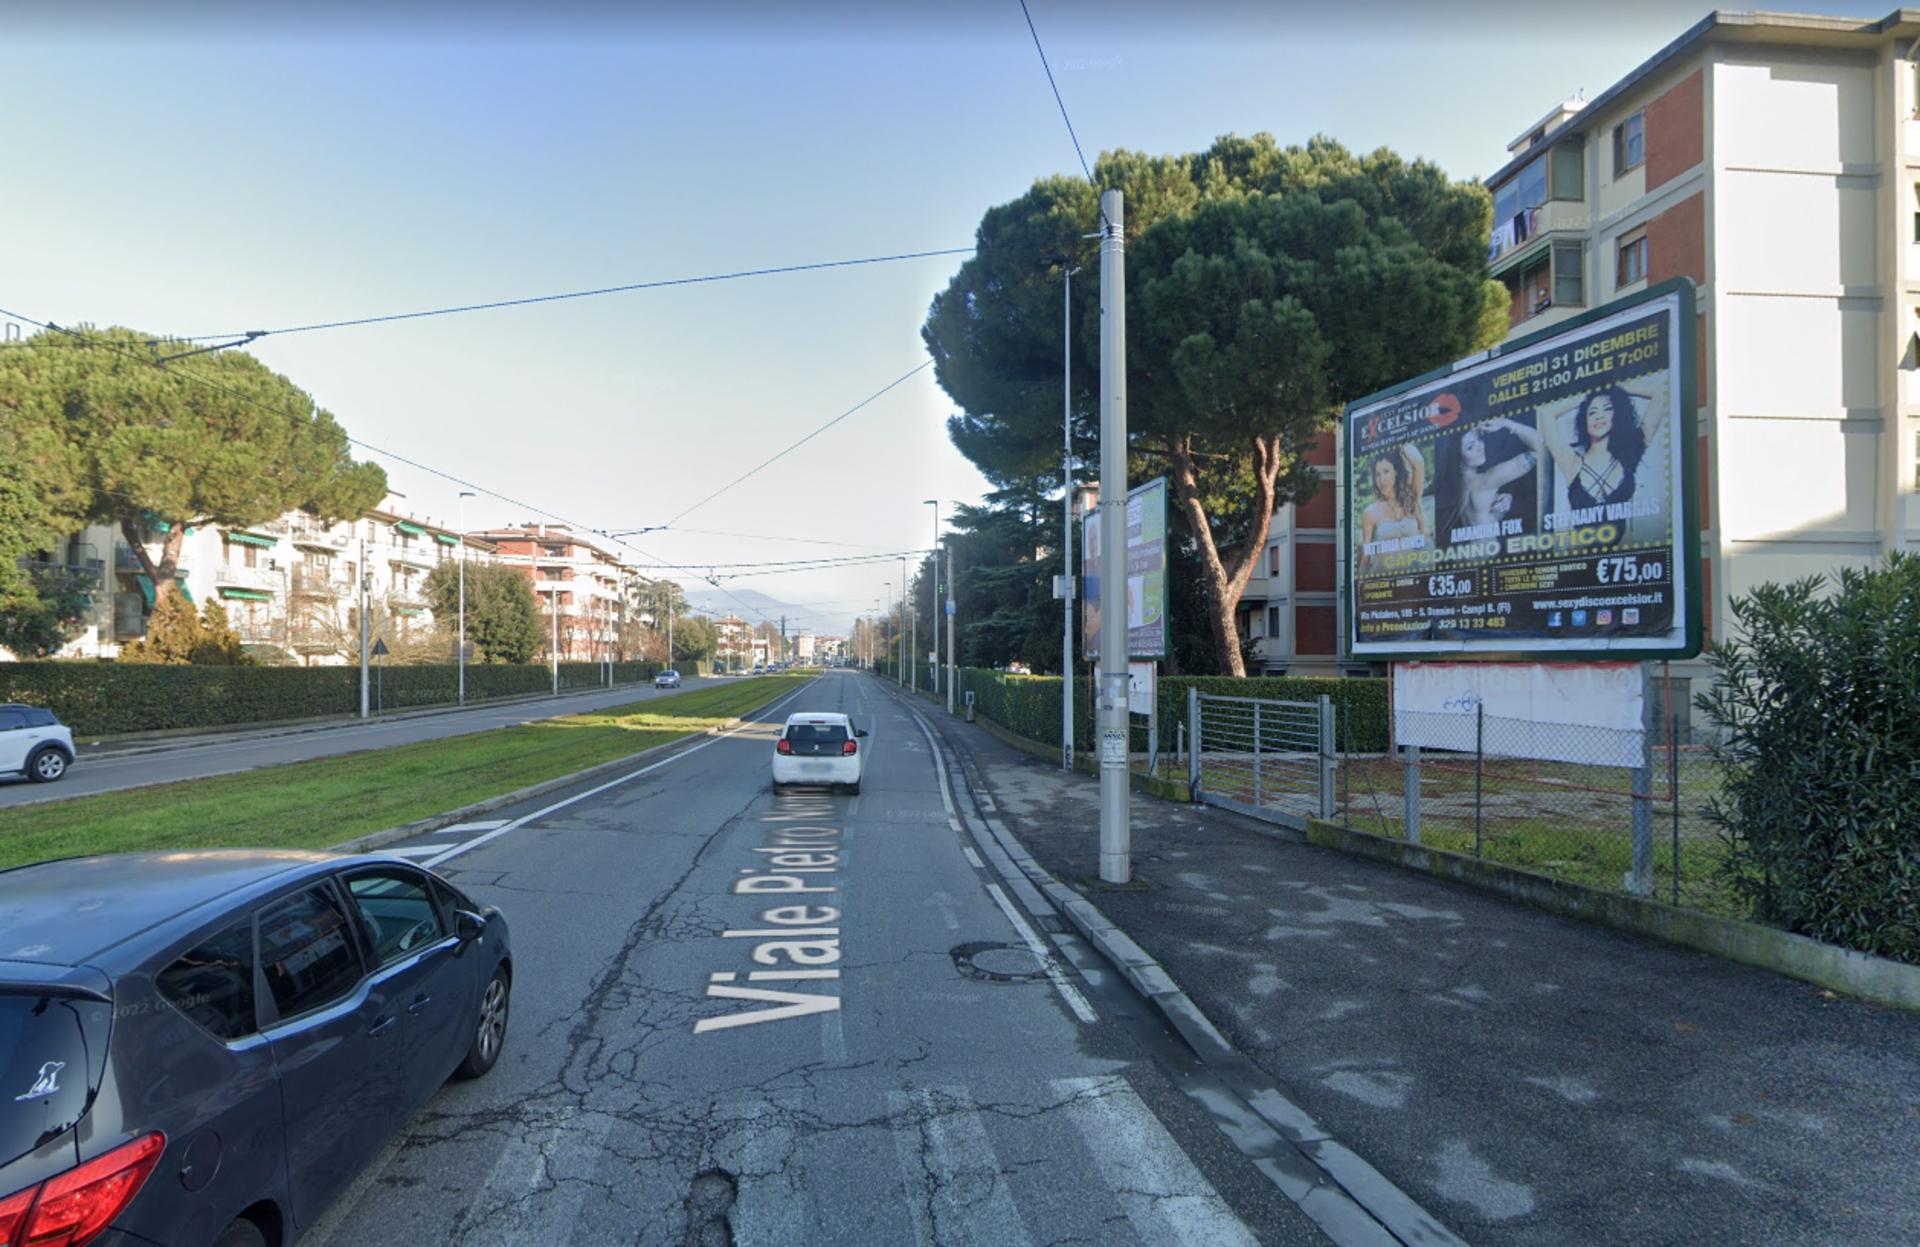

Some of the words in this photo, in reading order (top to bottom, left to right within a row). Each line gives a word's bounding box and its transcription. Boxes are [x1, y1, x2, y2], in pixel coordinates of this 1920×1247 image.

[1492, 357, 1548, 388] VENERDÌ
[1551, 353, 1569, 370] 31
[1574, 323, 1659, 362] DICEMBRE
[1488, 383, 1529, 406] DALLE
[1532, 371, 1571, 392] 21:00
[1575, 357, 1613, 380] ALLE
[1618, 342, 1659, 367] 7:00!
[1361, 402, 1440, 439] EXCELSIOR
[1502, 518, 1523, 535] FOX
[1544, 504, 1604, 530] STEPHANY
[1606, 498, 1660, 520] VARGAS
[1383, 541, 1500, 569] CAPODANNO
[1507, 524, 1617, 553] EROTICO
[1596, 556, 1663, 584] €75,00
[1428, 575, 1472, 598] €35,00
[1459, 618, 1470, 629] 13
[1472, 617, 1484, 628] 33
